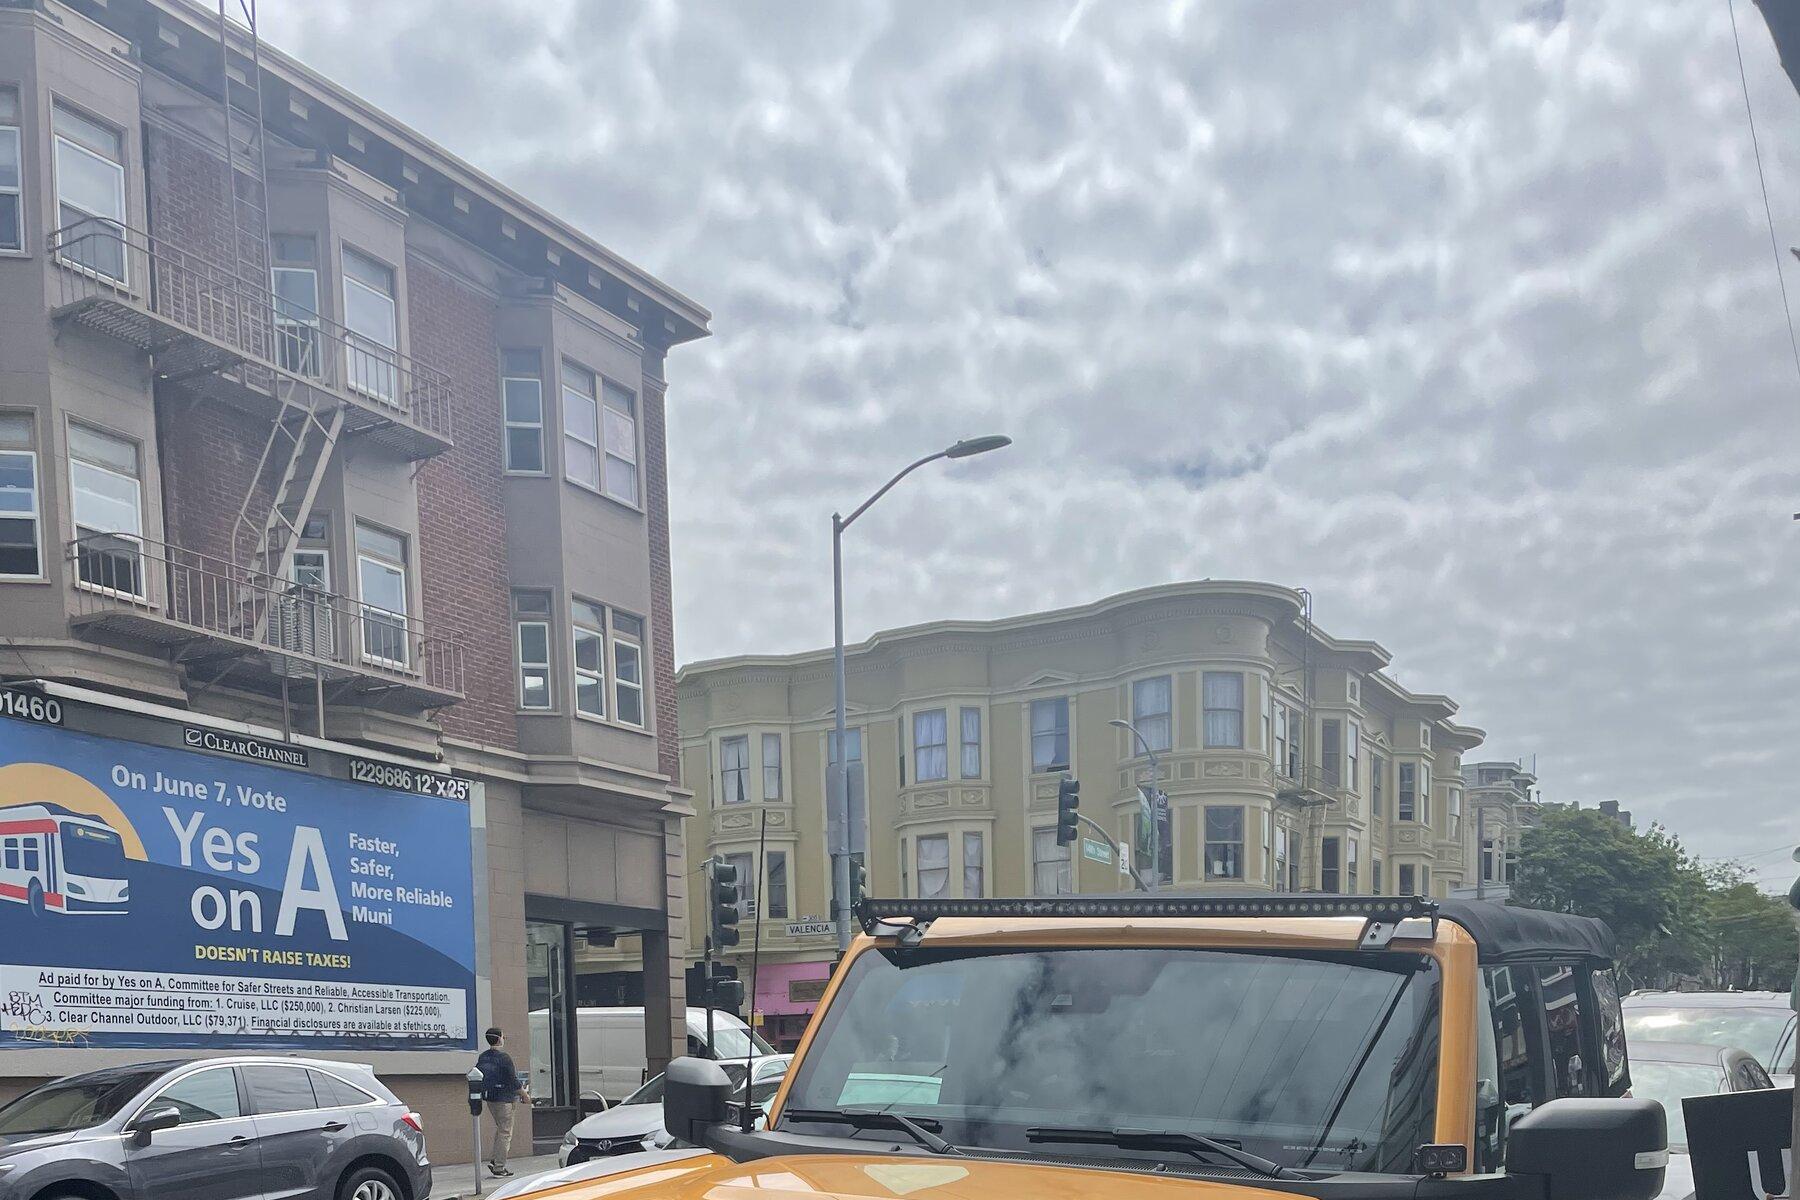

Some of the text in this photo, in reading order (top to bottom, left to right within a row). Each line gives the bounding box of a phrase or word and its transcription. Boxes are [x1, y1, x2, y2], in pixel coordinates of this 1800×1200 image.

[0, 691, 61, 723] 1460
[111, 764, 287, 812] On June 7, Vote
[350, 760, 411, 790] 1229686
[162, 806, 261, 874] Yes
[349, 832, 400, 858] Faster,
[350, 857, 394, 880] Safer,
[274, 825, 349, 941] A
[351, 881, 453, 908] More Reliable
[191, 886, 262, 932] on
[352, 905, 393, 925] Muni
[790, 924, 830, 934] VALENCIA
[195, 945, 351, 969] DOESN'T RAISE TAXES!
[39, 972, 54, 984] Ad
[58, 973, 80, 987] paid
[84, 974, 99, 986] for
[103, 975, 114, 990] by
[118, 976, 136, 988] Yes
[140, 979, 152, 988] on
[168, 978, 219, 991] Committee
[222, 981, 235, 992] for
[238, 981, 261, 993] Safer
[264, 983, 294, 995] Streets
[297, 986, 313, 995] and
[352, 988, 394, 999] Accessible
[53, 992, 112, 1005] Committee
[115, 995, 144, 1008] major
[147, 995, 185, 1009] funding
[188, 997, 213, 1008] from:
[216, 999, 224, 1009] 1.
[226, 998, 259, 1011] Cruise,
[261, 1000, 279, 1011] LLC
[328, 1002, 336, 1013] 2.
[338, 1003, 374, 1014] Christian
[375, 1004, 401, 1015] Larsen
[46, 1011, 56, 1022] 3.
[59, 1011, 88, 1022] Clear
[90, 1012, 134, 1023] Channel
[137, 1013, 180, 1026] Outdoor,
[183, 1014, 202, 1026] LLC
[251, 1016, 291, 1028] Financial
[293, 1018, 341, 1029] disclosures
[343, 1021, 356, 1030] are
[358, 1019, 392, 1030] available
[393, 1021, 401, 1031] at
